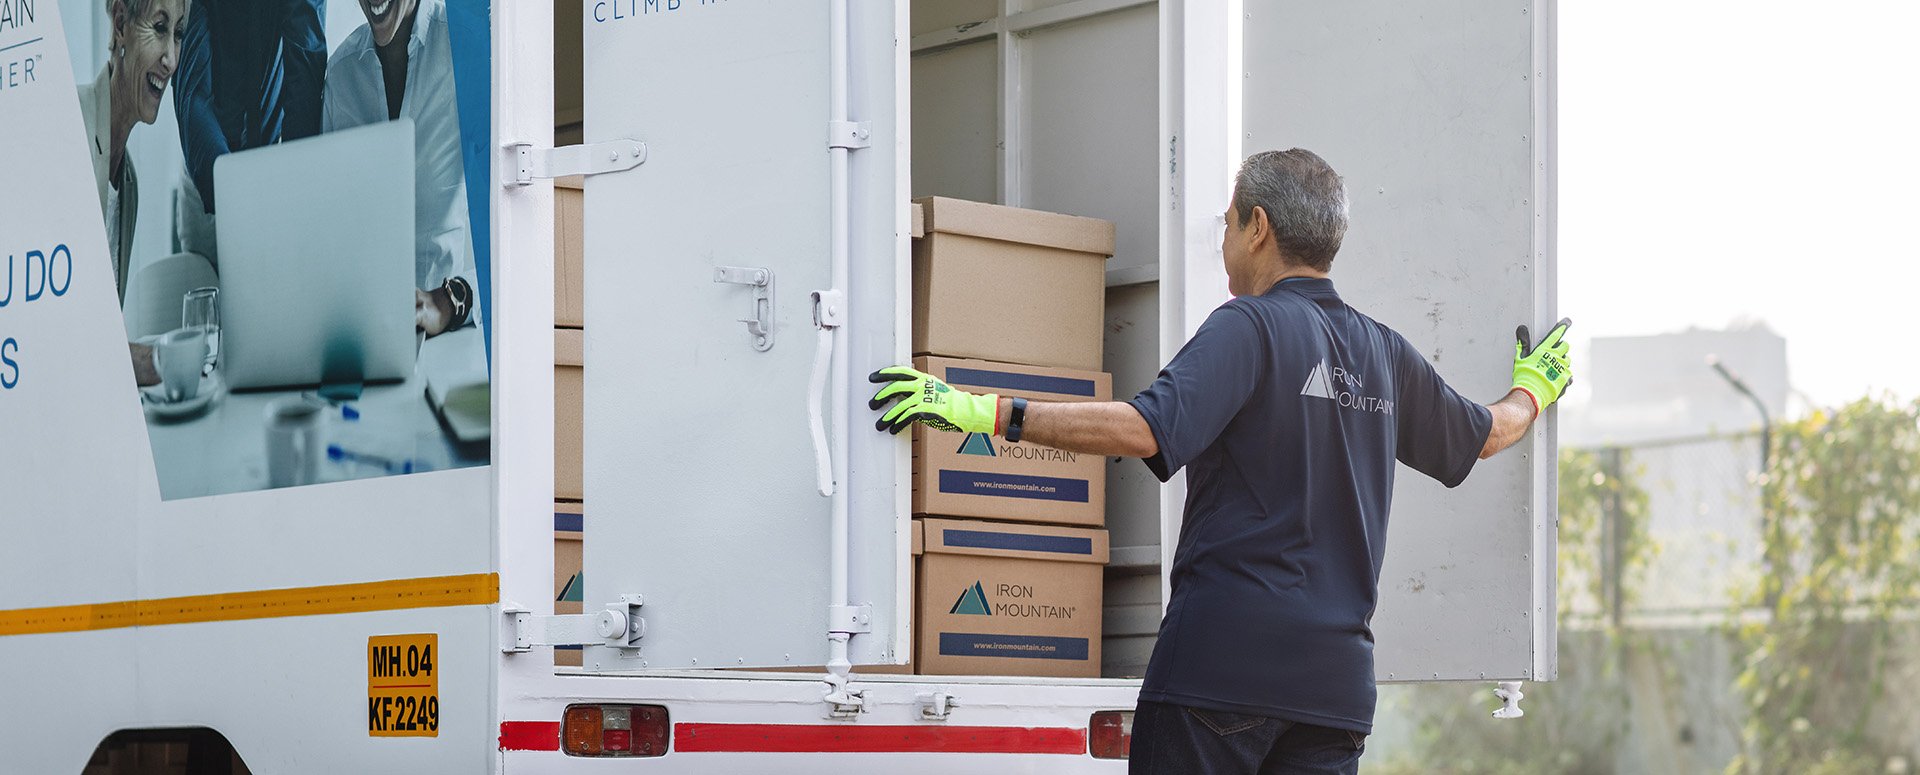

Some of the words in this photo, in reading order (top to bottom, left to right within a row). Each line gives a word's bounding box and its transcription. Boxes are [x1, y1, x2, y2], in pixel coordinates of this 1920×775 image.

[0, 0, 34, 32] AIN
[25, 243, 72, 302] DO
[973, 480, 1056, 493] www.ironmountain.com
[996, 583, 1033, 598] IRON
[373, 644, 432, 677] MH.04
[973, 641, 1056, 653] www.ironmountain.com
[369, 695, 439, 731] KF.2249
